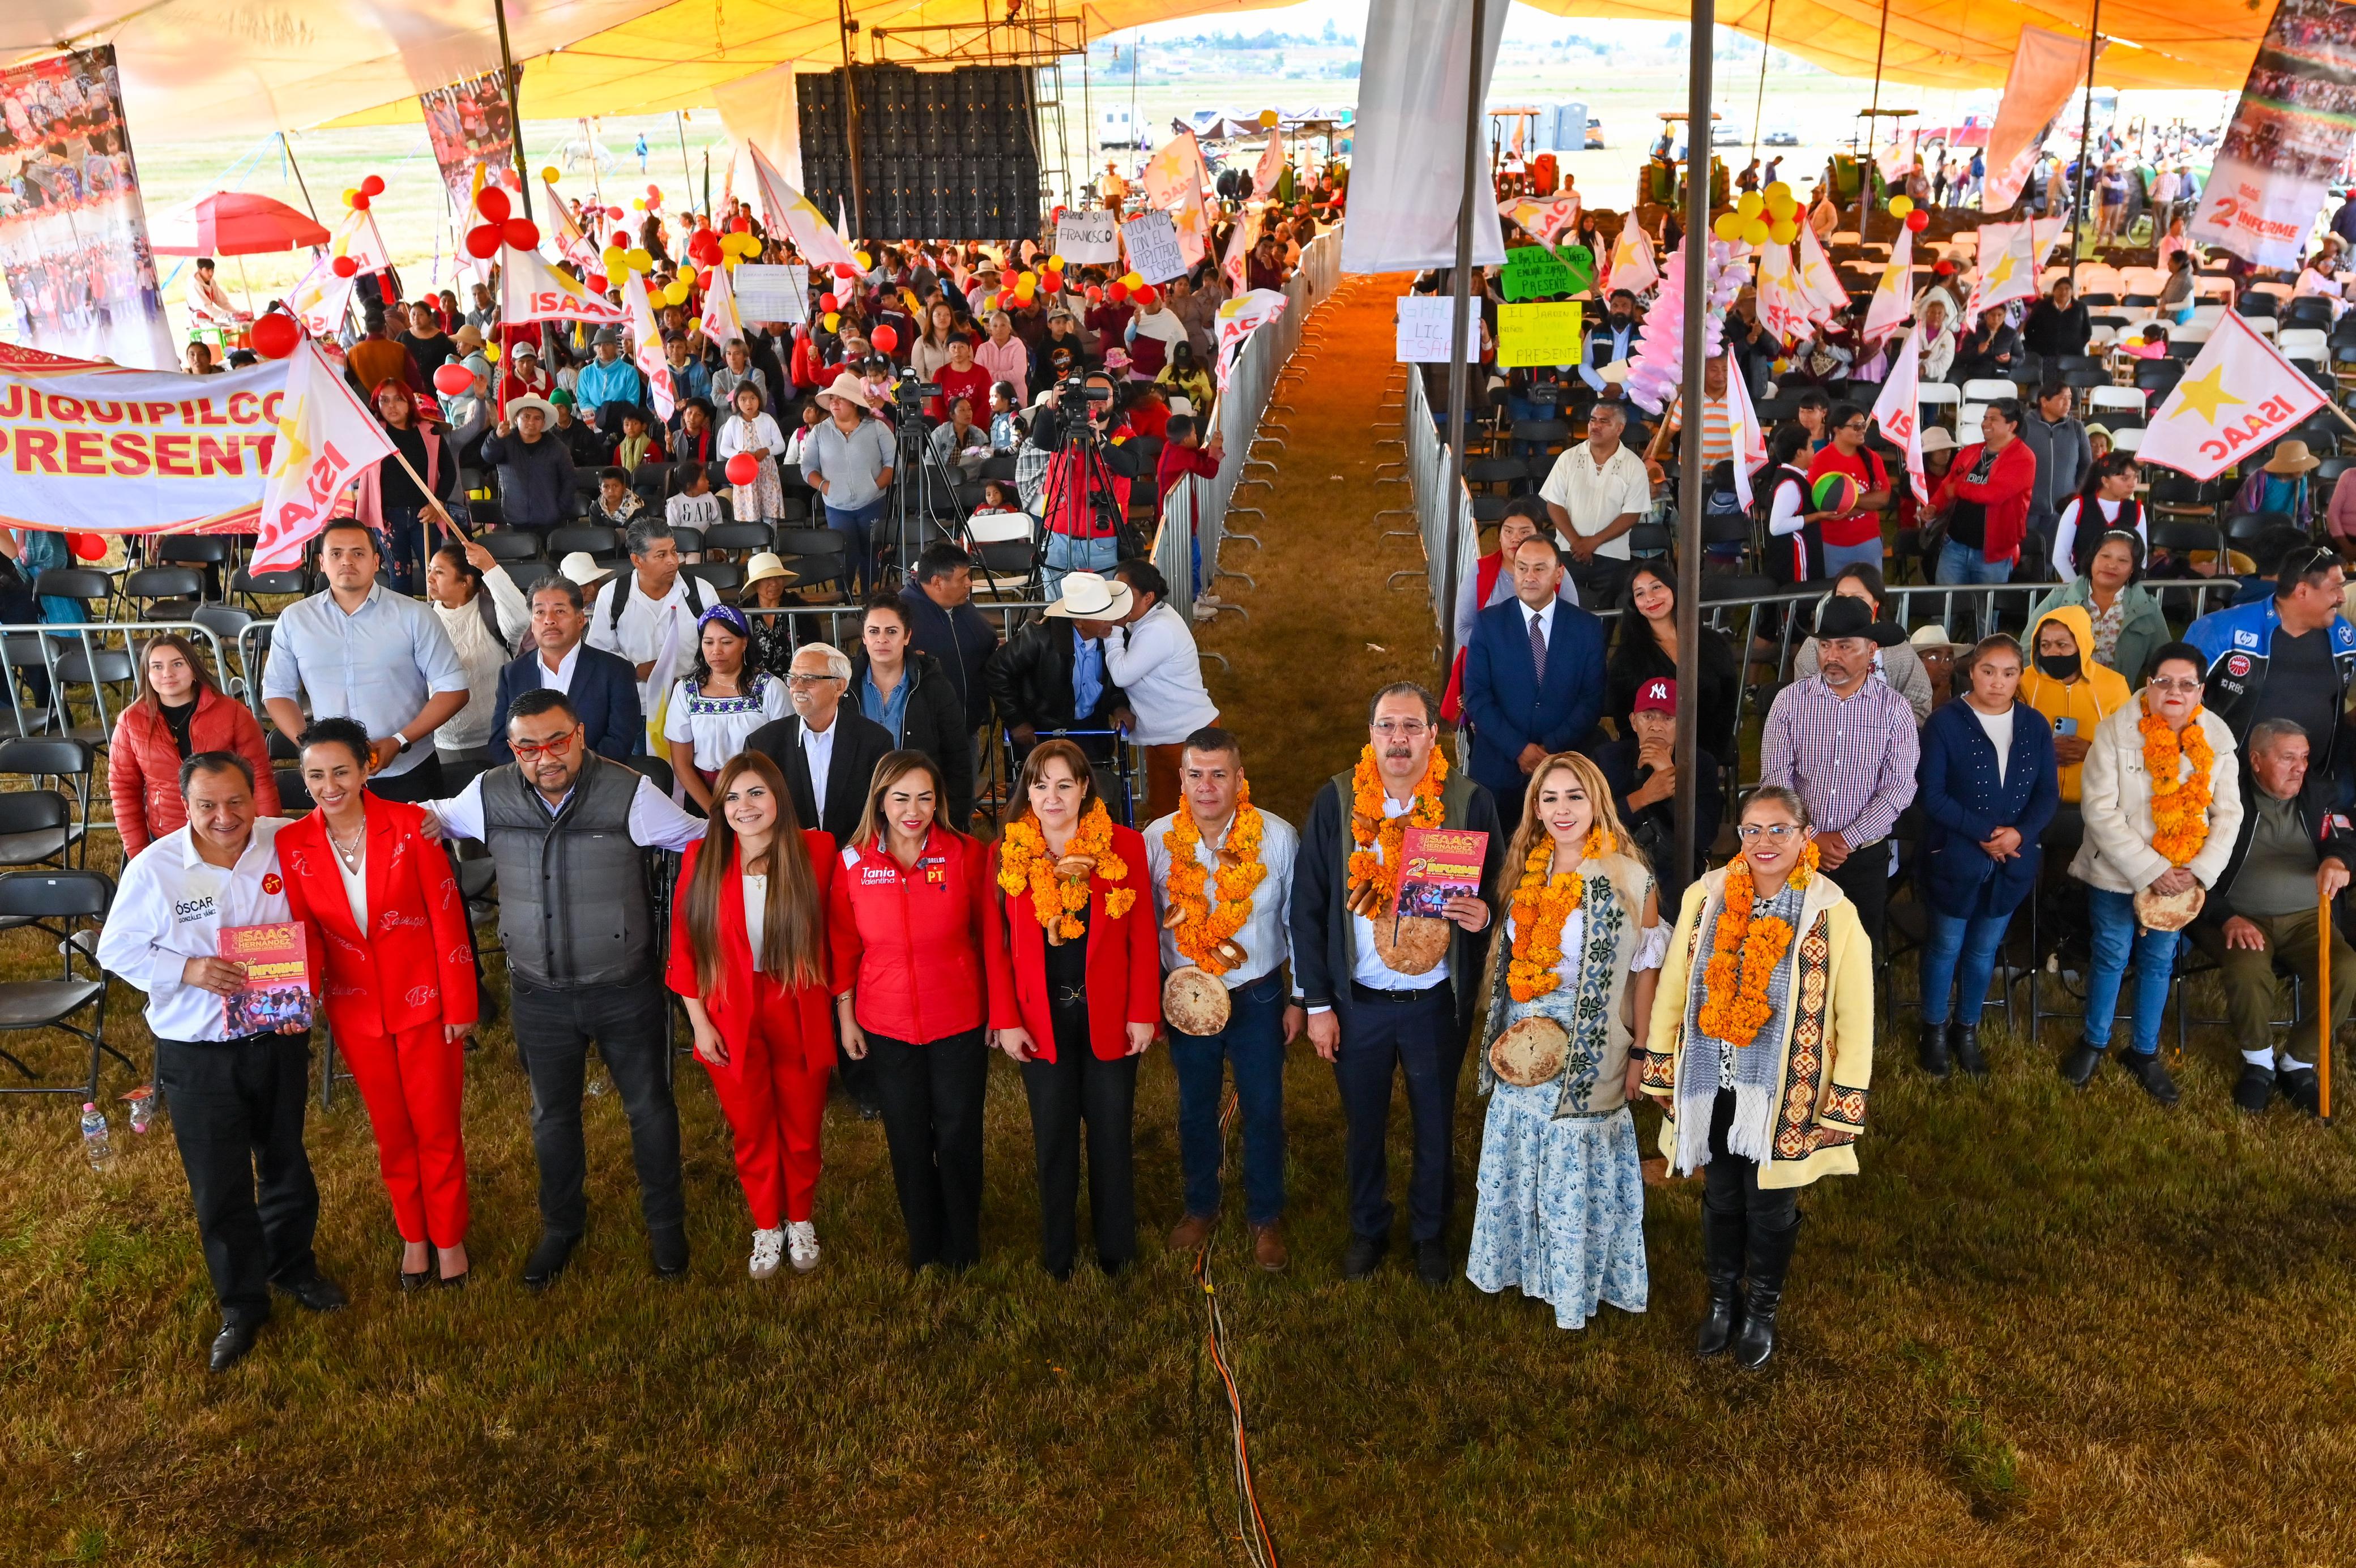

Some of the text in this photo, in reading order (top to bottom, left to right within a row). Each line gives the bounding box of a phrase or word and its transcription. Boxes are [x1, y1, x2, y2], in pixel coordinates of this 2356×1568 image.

[1059, 210, 1108, 223] BARRIO SAN
[2238, 210, 2299, 238] INFORME
[1133, 229, 1165, 254] CON EL
[1522, 277, 1568, 294] PRESENTE
[1517, 347, 1580, 364] PRESENTE
[0, 428, 276, 476] RESENT
[2228, 681, 2244, 695] RBS
[1425, 834, 1473, 846] ISAAC
[862, 866, 895, 878] Tania
[928, 870, 943, 882] PT
[1427, 863, 1480, 876] INFORME
[265, 879, 280, 893] PT
[176, 896, 214, 915] ÓSCAR
[178, 909, 217, 924] GONZÁLEZ YÁÑEZ
[238, 928, 290, 942] ISAAC
[248, 961, 304, 976] INFORME
